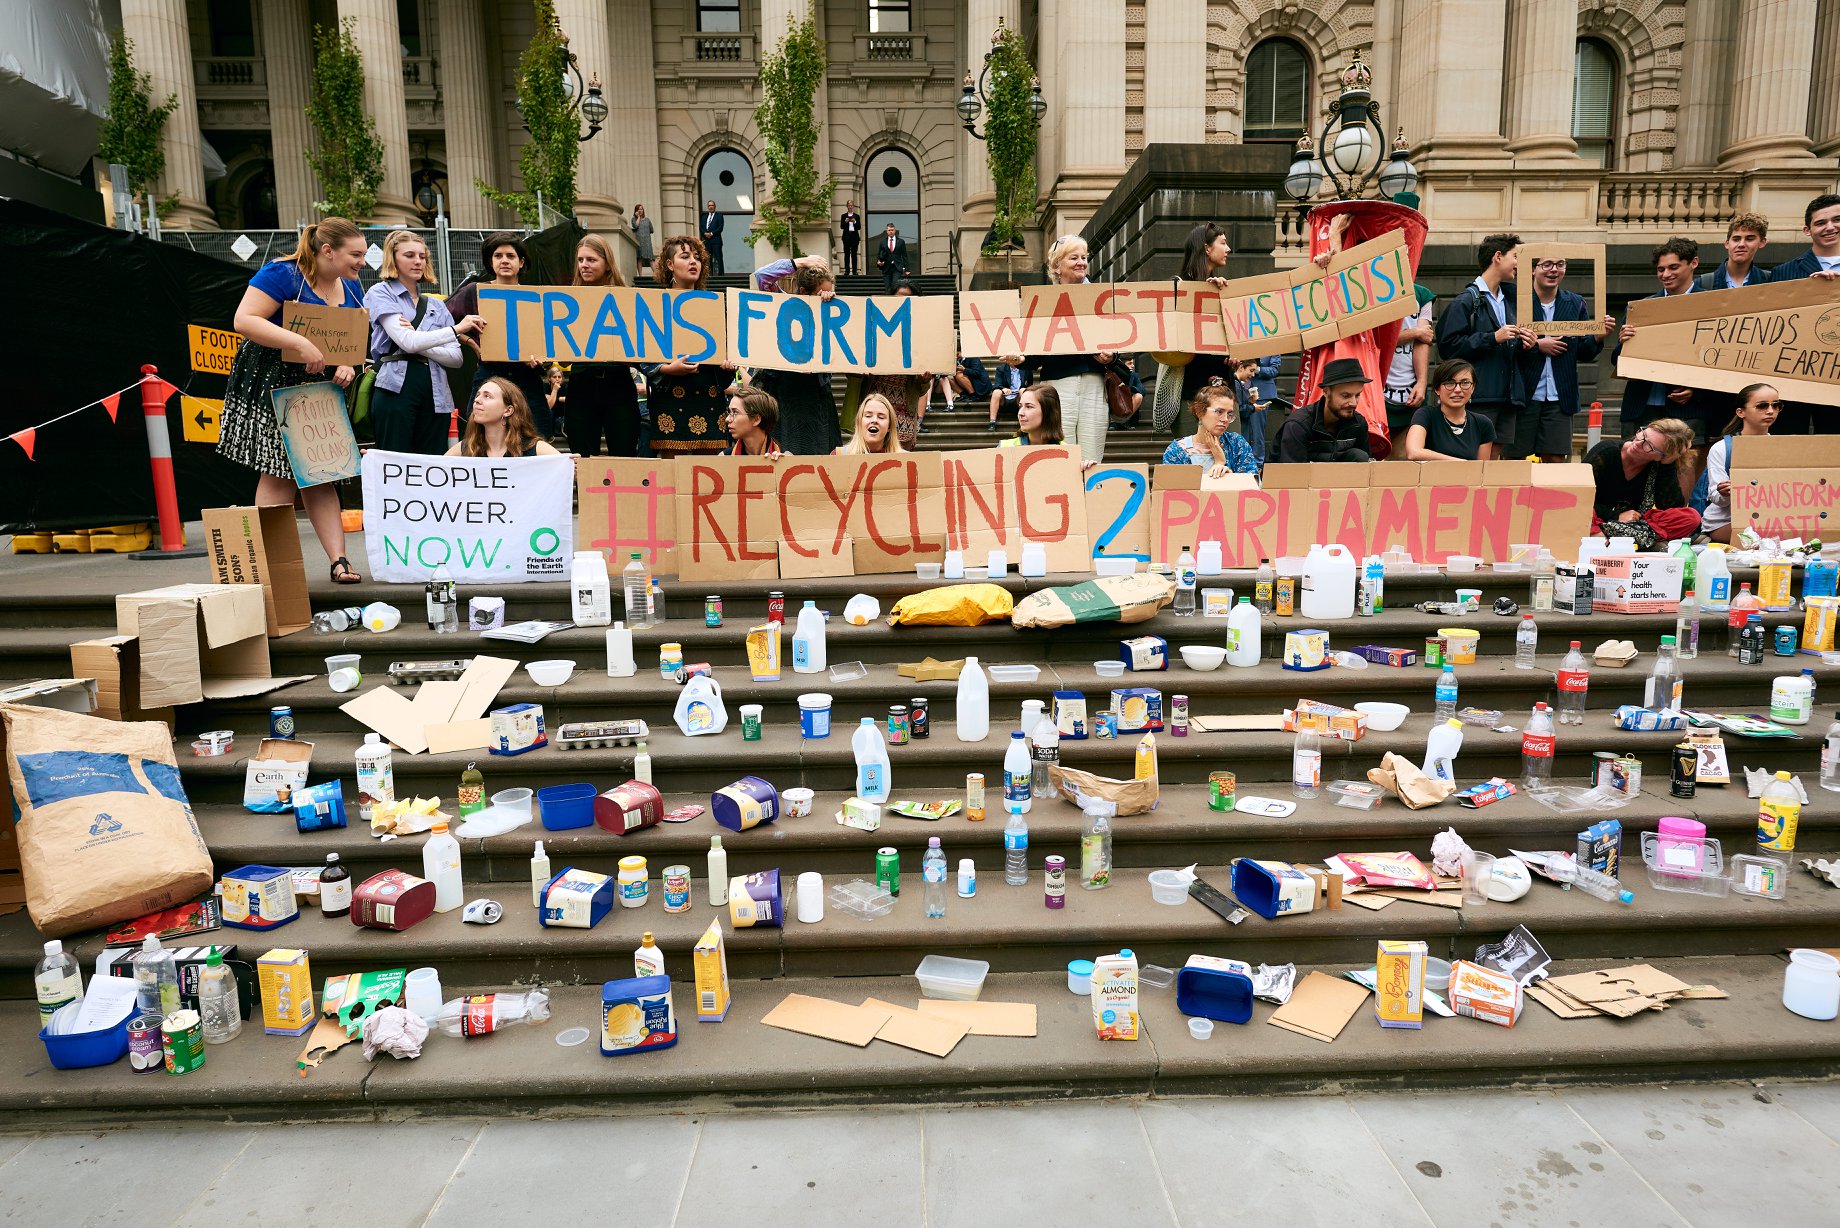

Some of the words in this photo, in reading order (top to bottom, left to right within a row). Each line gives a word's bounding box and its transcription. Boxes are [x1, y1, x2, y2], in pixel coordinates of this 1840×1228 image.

[970, 288, 1228, 354] WASTE
[1693, 314, 1800, 345] FRIENDS
[1704, 347, 1728, 366] OF
[1735, 349, 1765, 369] THE
[1774, 347, 1840, 380] EARTH
[293, 399, 336, 422] PROTECT
[302, 421, 341, 442] OUR
[306, 439, 350, 462] OCEANS
[382, 463, 516, 489] PEOPLE.
[382, 498, 514, 524] POWER.
[242, 515, 251, 537] Apples
[212, 529, 228, 566] SMITH
[246, 539, 257, 564] Organic
[383, 535, 511, 569] NOW.
[1633, 561, 1650, 570] Your
[1630, 581, 1653, 590] health
[1632, 572, 1644, 581] gut
[1630, 591, 1650, 600] starts
[1650, 591, 1668, 600] here.
[1771, 700, 1795, 708] rotein
[50, 772, 81, 782] Product
[255, 772, 284, 784] earth
[1475, 790, 1496, 803] Colgate
[1101, 986, 1137, 995] ALMOND
[646, 1016, 668, 1026] Ribbon
[649, 1022, 665, 1031] Blue
